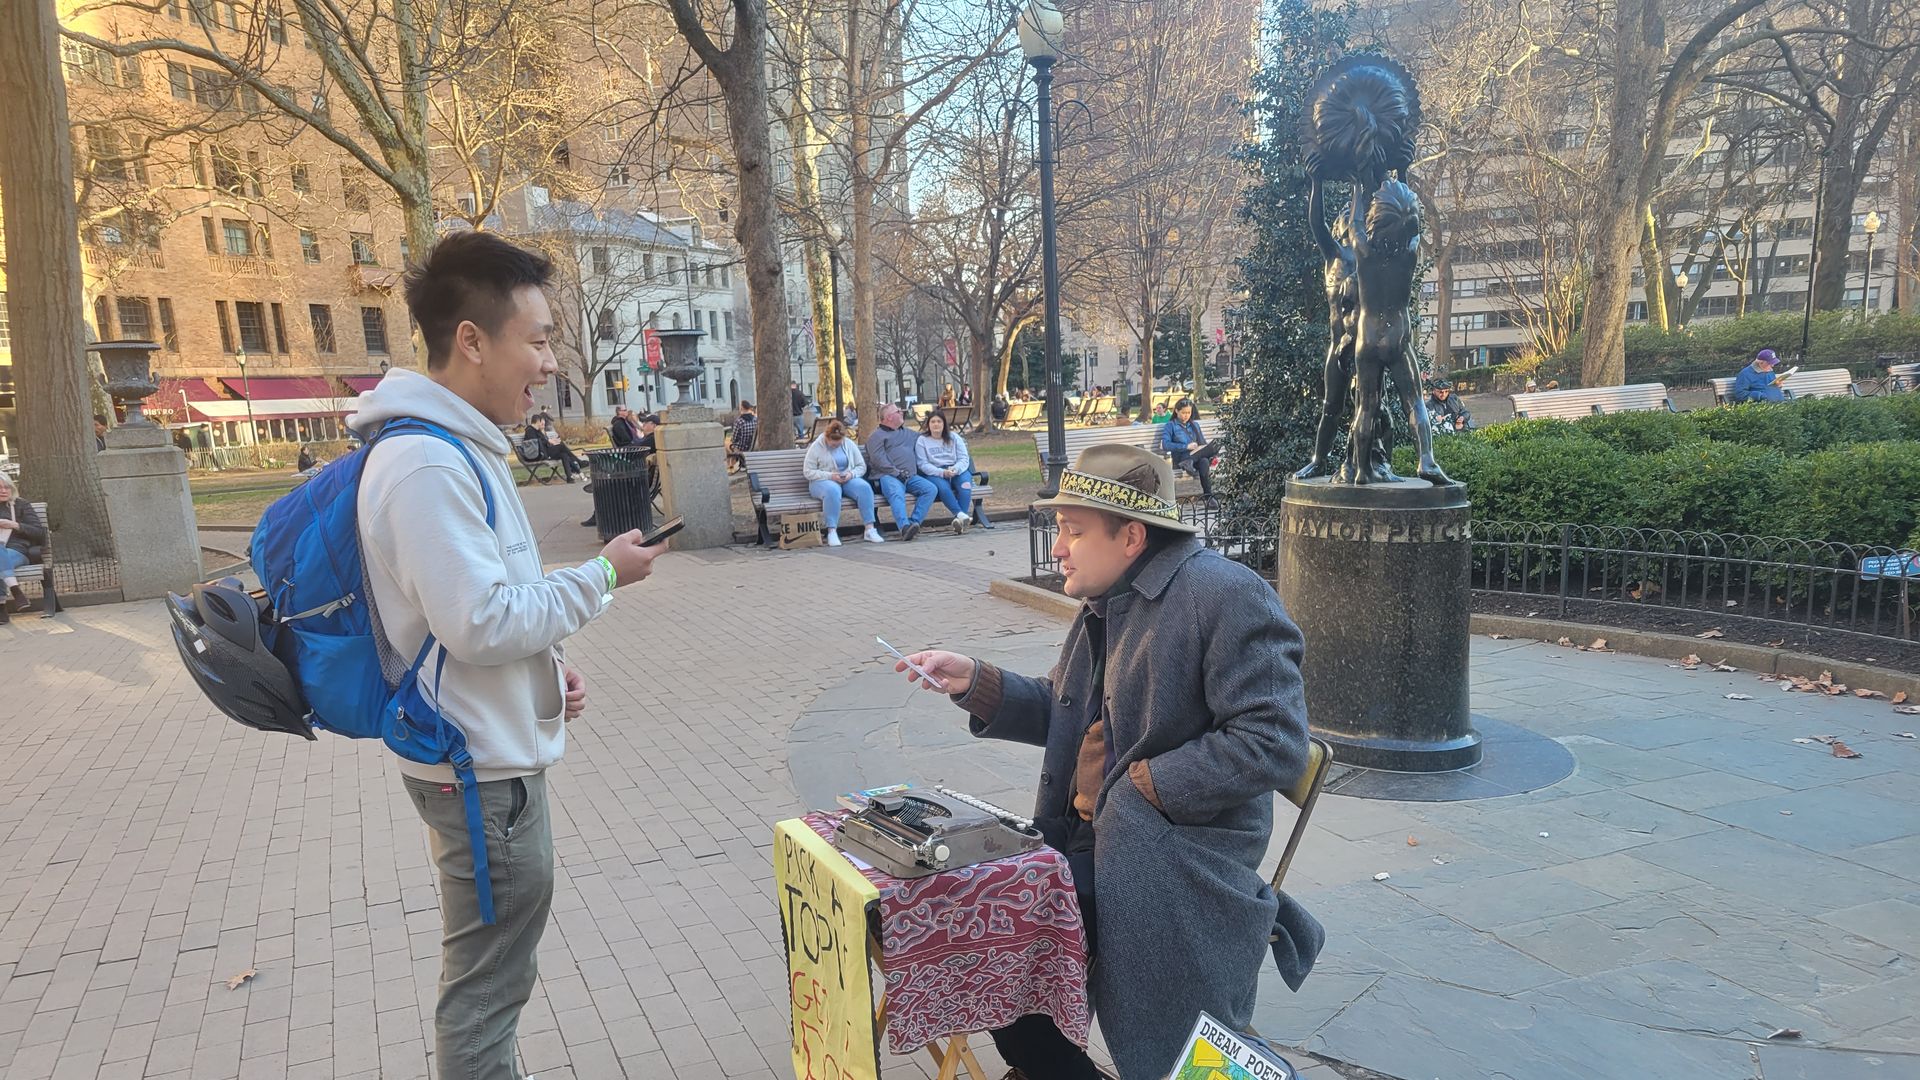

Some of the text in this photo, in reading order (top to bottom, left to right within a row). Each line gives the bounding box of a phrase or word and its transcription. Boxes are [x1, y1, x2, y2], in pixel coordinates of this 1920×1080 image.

[143, 408, 174, 416] BISTRO
[784, 832, 820, 901] PICK
[1200, 1021, 1282, 1080] DREAM POET
